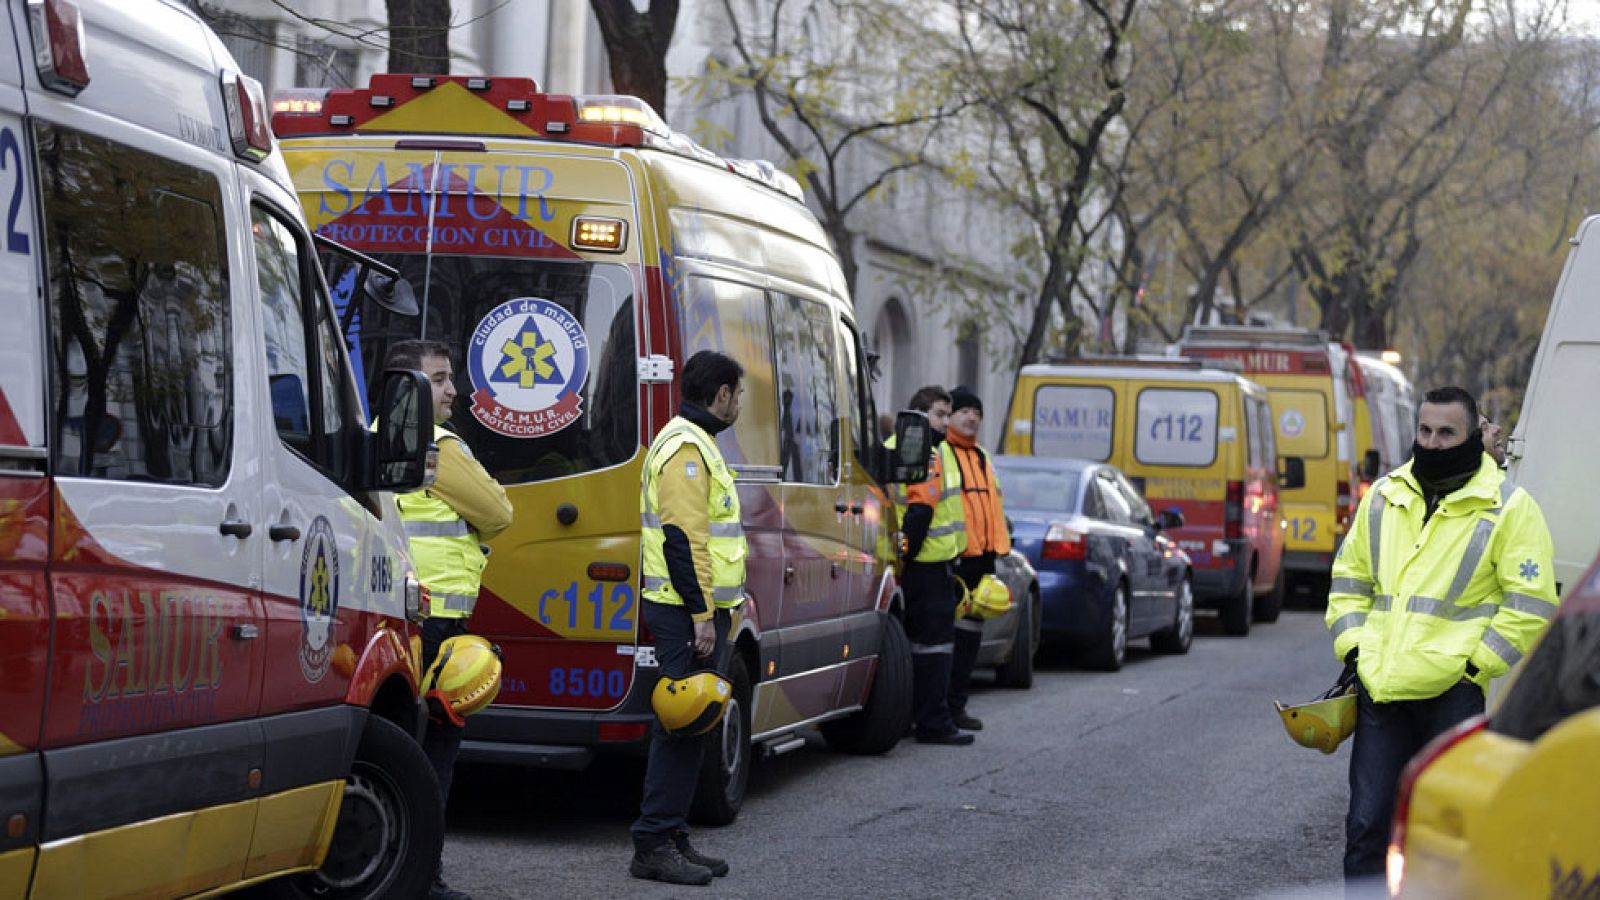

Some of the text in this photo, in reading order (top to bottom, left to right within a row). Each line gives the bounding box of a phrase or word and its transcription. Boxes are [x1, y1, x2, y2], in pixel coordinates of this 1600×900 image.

[319, 159, 556, 222] SAMUR
[316, 223, 554, 248] PROTECCION CIVIL
[475, 301, 585, 349] ciudad de madrid
[1224, 352, 1290, 371] AMUR
[478, 407, 575, 434] PROTECCION CIVIL
[371, 554, 393, 593] 8169
[83, 589, 224, 704] SAMUR
[549, 667, 625, 697] 8500
